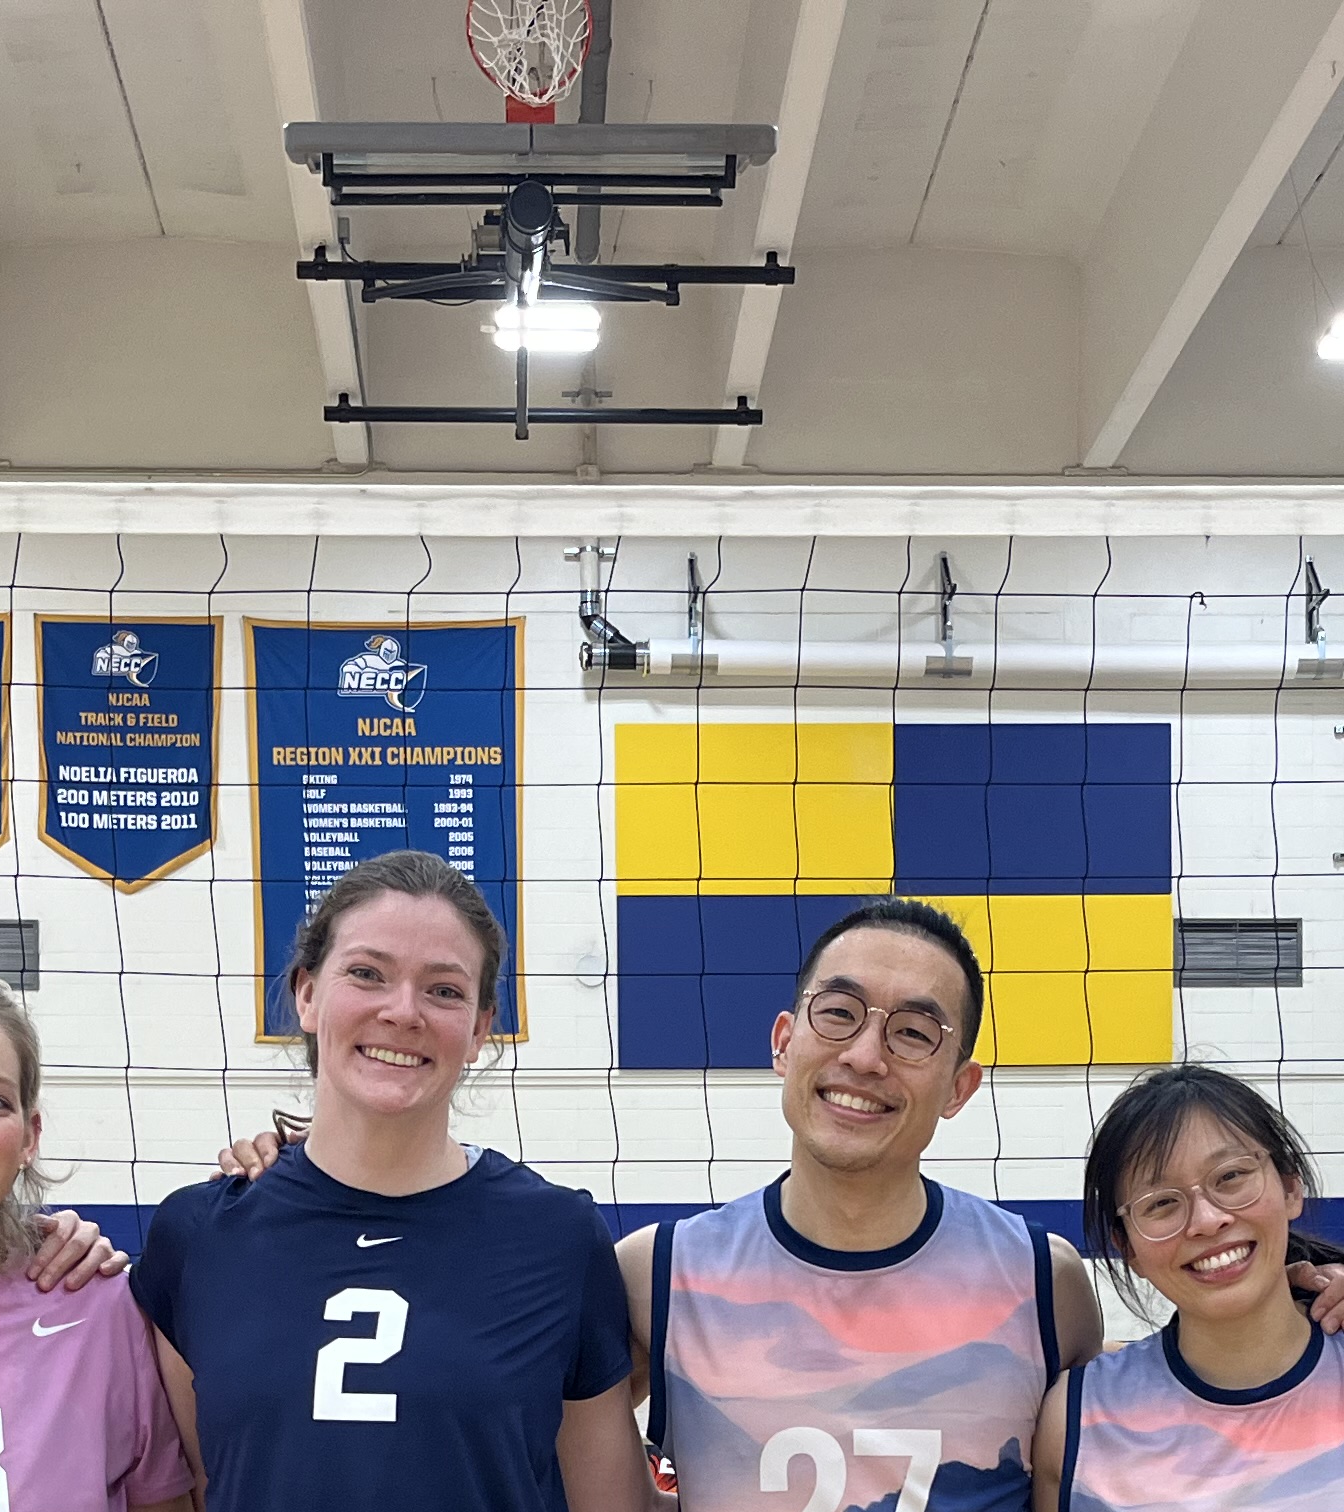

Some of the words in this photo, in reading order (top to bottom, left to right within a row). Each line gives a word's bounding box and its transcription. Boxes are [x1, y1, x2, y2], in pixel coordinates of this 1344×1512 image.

[96, 657, 141, 673] NECC
[343, 671, 405, 690] NECC
[109, 693, 150, 706] NJCAA
[79, 712, 123, 726] TRACK
[139, 712, 178, 727] FIELD
[357, 718, 417, 736] NJCAA
[56, 731, 123, 746] NATIONAL
[126, 732, 200, 748] CHAMPION
[272, 747, 343, 766] REGION
[348, 747, 382, 766] XXI
[386, 747, 502, 766] CHAMPIONS
[59, 765, 116, 783] NOELIA
[120, 767, 199, 784] FIGUEROA
[449, 774, 473, 785] 1974
[56, 789, 89, 806] 200
[92, 790, 157, 807] METERS
[160, 790, 199, 807] 2010
[448, 789, 473, 799] 1993
[59, 811, 89, 829] 100
[92, 812, 157, 830] METERS
[160, 813, 198, 830] 2011
[350, 817, 408, 828] BASKETBALL
[313, 1287, 409, 1422] 2
